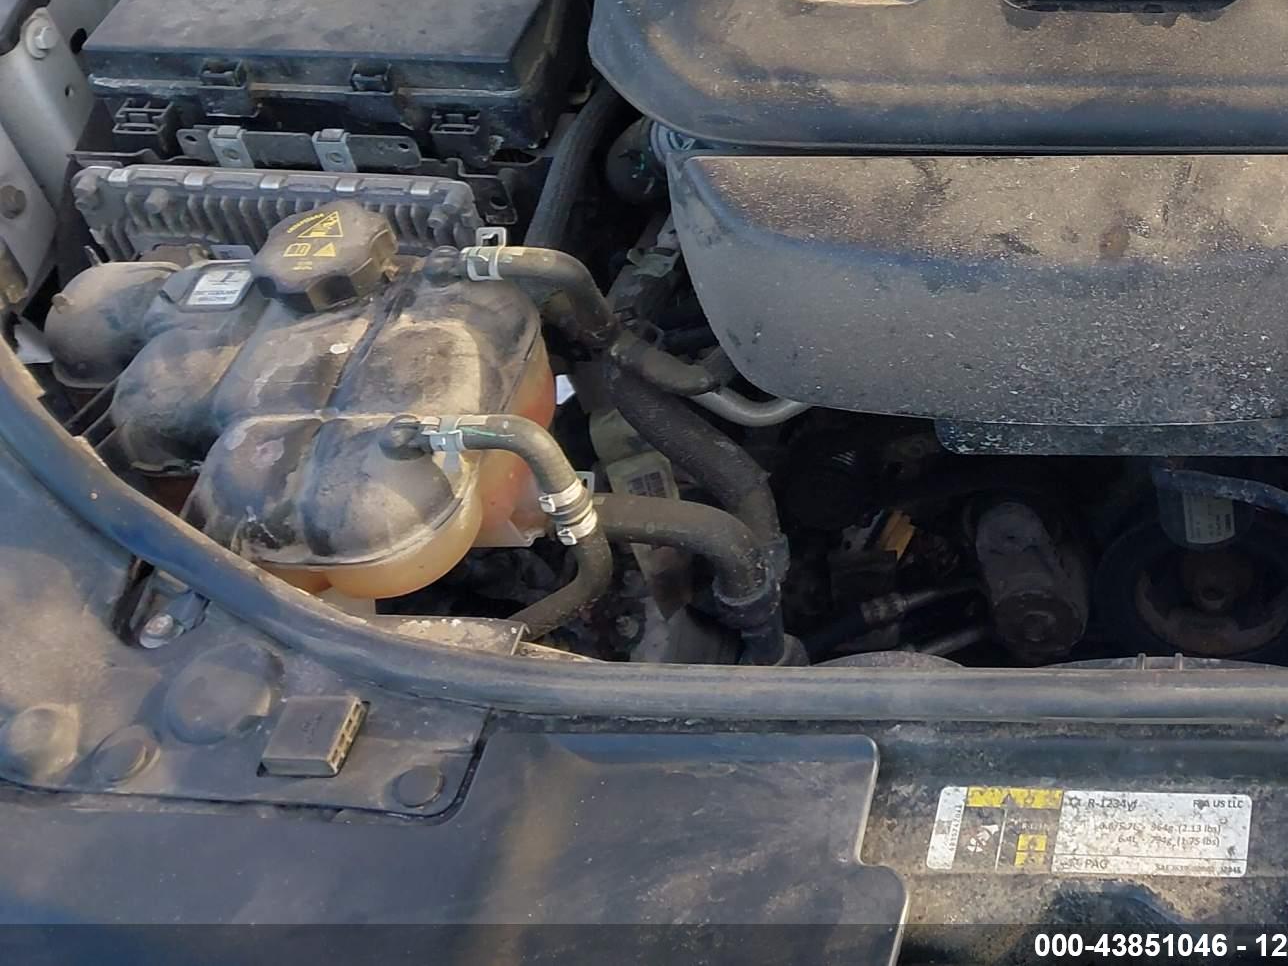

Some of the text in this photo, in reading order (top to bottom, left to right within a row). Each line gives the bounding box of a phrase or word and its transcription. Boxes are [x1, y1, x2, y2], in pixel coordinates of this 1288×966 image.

[1087, 798, 1138, 811] R-1234yf
[1212, 799, 1225, 809] US
[1227, 800, 1243, 809] LLC
[1204, 824, 1221, 835] lbs)
[1202, 836, 1220, 847] lbs)
